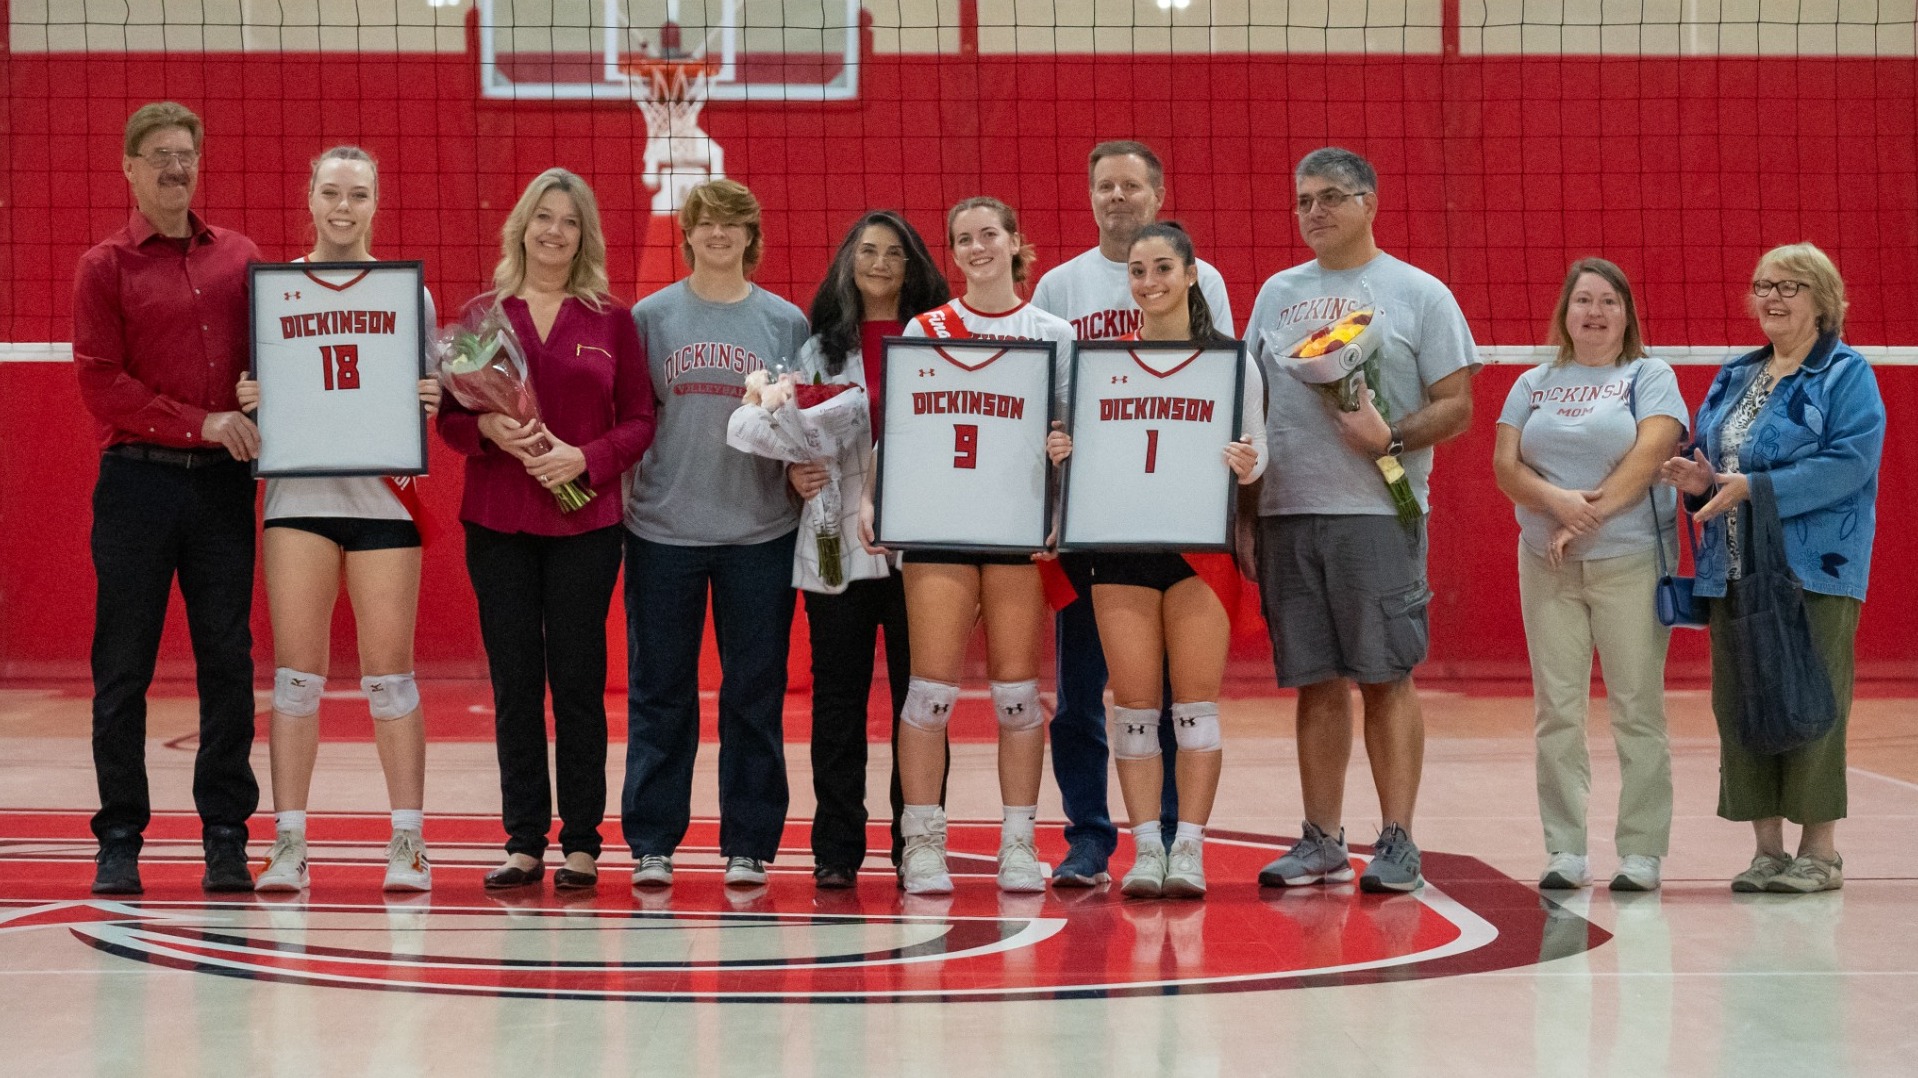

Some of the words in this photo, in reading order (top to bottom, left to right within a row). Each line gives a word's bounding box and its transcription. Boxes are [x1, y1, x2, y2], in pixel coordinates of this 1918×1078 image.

[280, 310, 397, 339] DICKINSON
[319, 344, 360, 391] 18
[911, 390, 1025, 420] DICKINSON
[1099, 396, 1215, 423] DICKINSON
[1556, 405, 1595, 417] MOM
[953, 423, 978, 470] 9
[1144, 429, 1159, 474] 1
